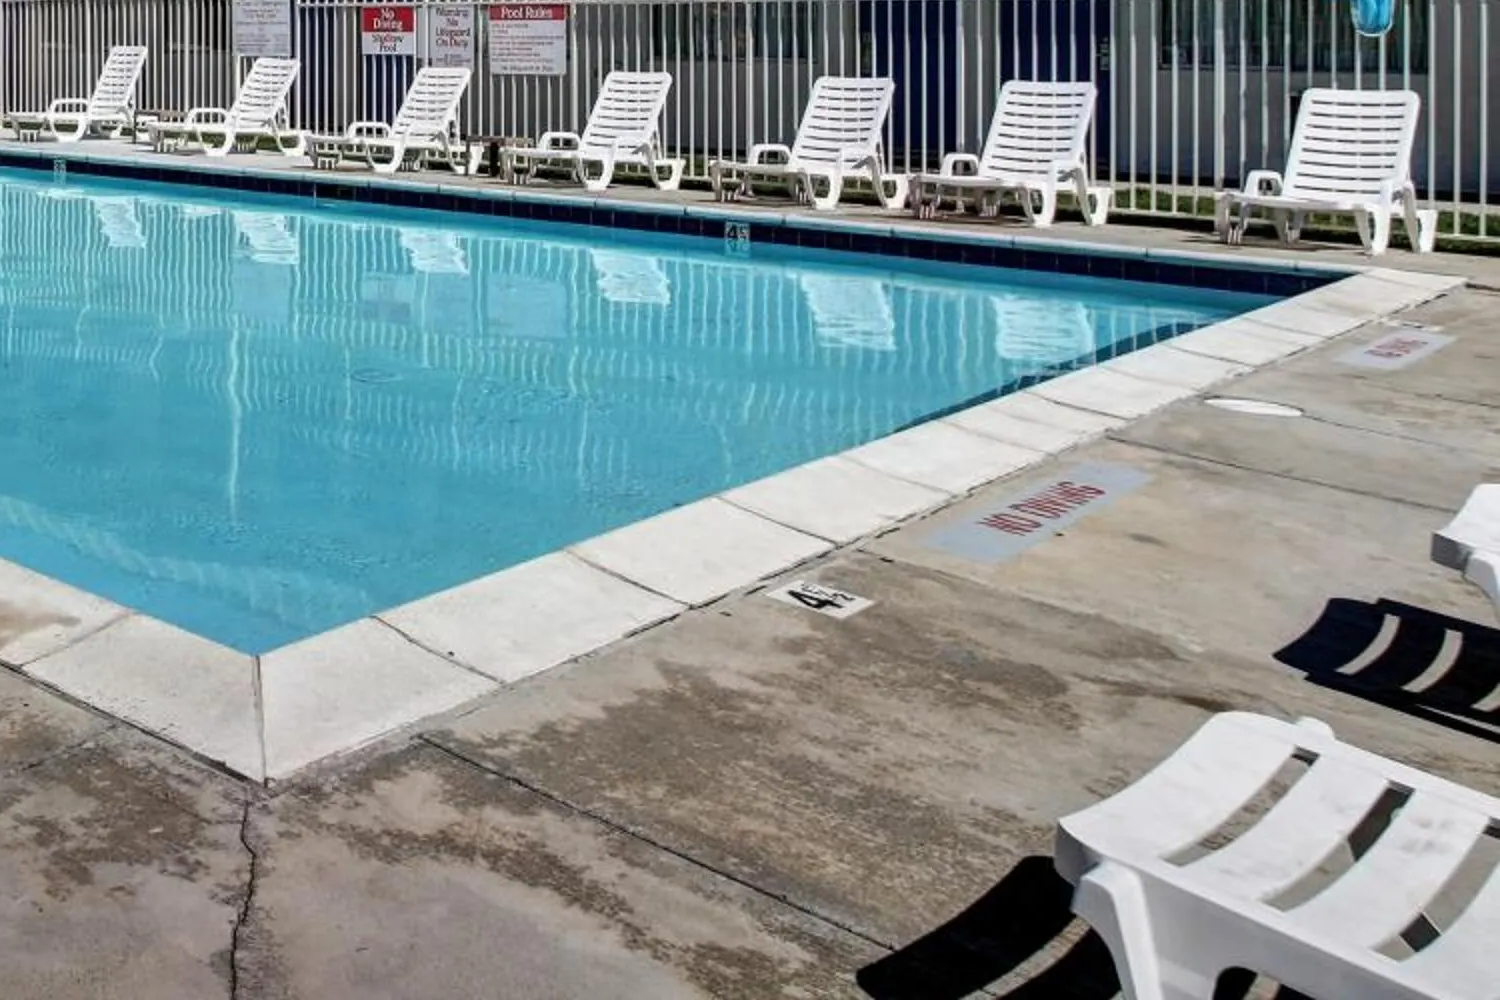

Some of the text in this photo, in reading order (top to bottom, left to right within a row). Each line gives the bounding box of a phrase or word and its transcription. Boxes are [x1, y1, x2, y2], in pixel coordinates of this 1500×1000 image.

[381, 7, 396, 21] No
[501, 5, 553, 19] Pool Rules
[372, 17, 403, 31] Diving
[975, 480, 1107, 537] NO DIVING
